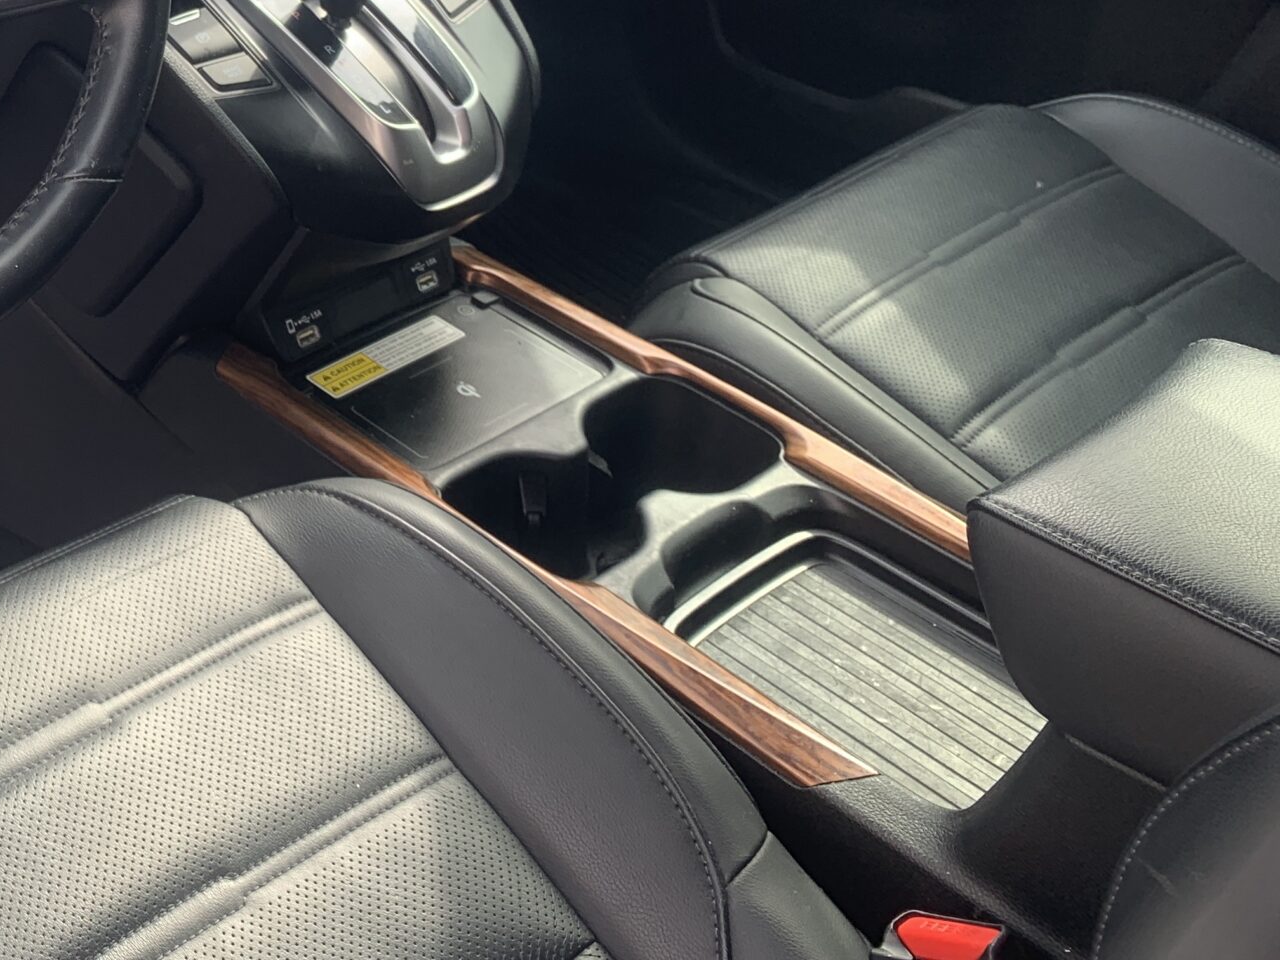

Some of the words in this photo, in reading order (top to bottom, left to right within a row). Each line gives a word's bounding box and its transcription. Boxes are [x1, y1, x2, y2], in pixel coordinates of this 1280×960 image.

[324, 45, 335, 54] R
[330, 357, 365, 377] CAUTION
[339, 365, 382, 387] ATTENTION
